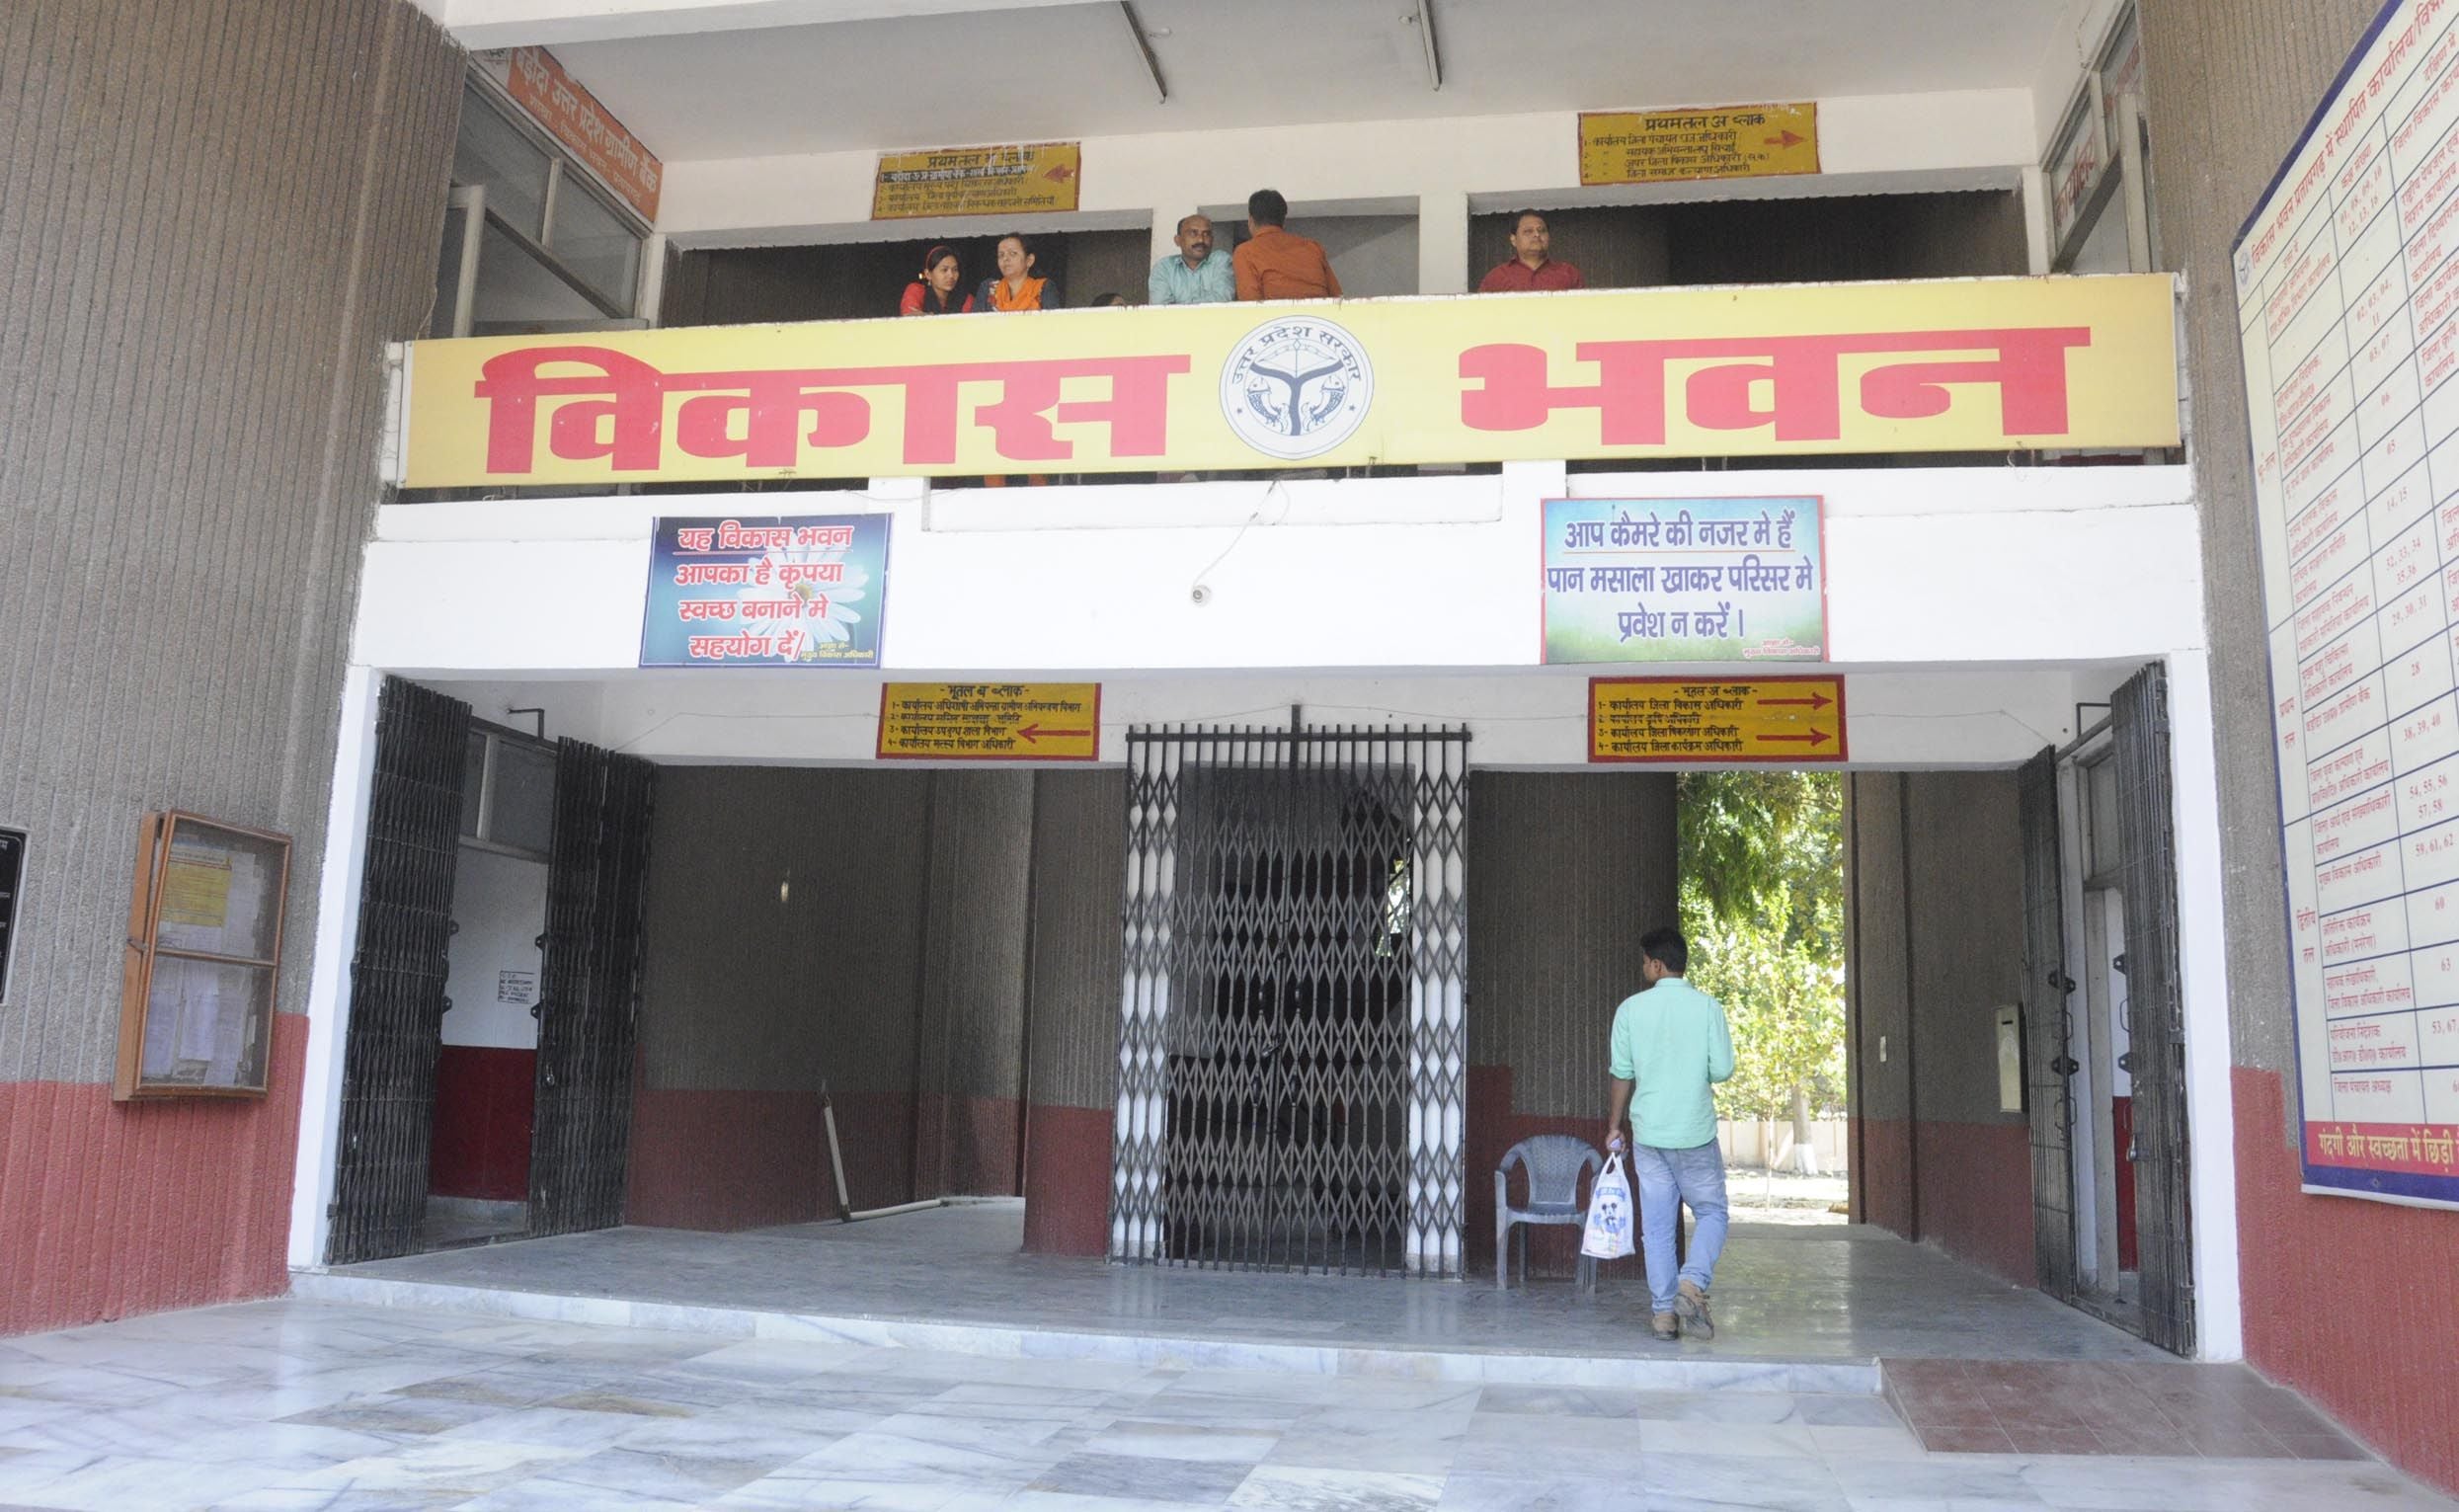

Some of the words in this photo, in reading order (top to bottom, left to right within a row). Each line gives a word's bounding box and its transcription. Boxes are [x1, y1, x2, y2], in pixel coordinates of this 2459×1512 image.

[1711, 116, 1728, 127] अ
[581, 103, 604, 147] प्रदेश
[604, 129, 638, 178] ग्रामीण
[2252, 223, 2275, 268] विकास
[2276, 197, 2294, 230] भवन
[2335, 90, 2366, 146] स्थापित
[1232, 347, 1257, 384] उत्तर
[1258, 326, 1313, 347] प्रदेश
[1318, 330, 1362, 382] सरकार
[475, 346, 1191, 474] विकास
[1459, 327, 2091, 445] भवन
[678, 528, 714, 549] यह
[719, 520, 793, 549] विकास
[798, 526, 854, 546] भवन
[1564, 521, 1605, 548] आप
[1610, 511, 1661, 547] कैमरे
[1665, 510, 1693, 547] की
[1699, 520, 1748, 546] नजर
[1753, 511, 1771, 546] मे
[674, 563, 749, 585] आपका
[754, 557, 772, 585] है
[778, 563, 843, 590] कृपया
[1547, 567, 1584, 593] पान
[1590, 567, 1655, 593] मसाला
[1660, 566, 1723, 594] खाकर
[1728, 554, 1790, 592] परिसर
[1794, 555, 1813, 591] मे
[679, 600, 737, 621] स्वच्छ
[742, 593, 803, 619] बनाने
[1618, 602, 1665, 643] प्रवेश
[1671, 611, 1689, 638] न
[1694, 601, 1731, 638] करें
[689, 630, 771, 657] सहयोग
[902, 698, 934, 710] कार्यालय
[1610, 698, 1646, 710] कार्यालय
[1649, 697, 1671, 710] जिला
[1673, 697, 1703, 710] विकास
[1704, 697, 1744, 710] अधिकारी
[900, 736, 931, 749] कार्यालय
[981, 737, 1016, 751] अधिकारी
[901, 723, 934, 736] कार्यालय
[1611, 726, 1645, 738] कार्यालय
[1704, 724, 1739, 737] अधिकारी
[1612, 739, 1648, 752] कार्यालय
[1705, 739, 1744, 752] अधिकारी
[2318, 1126, 2343, 1161] गंदगी
[2346, 1123, 2365, 1159] और
[2368, 1135, 2410, 1162] स्वच्छता
[2411, 1128, 2421, 1163] में
